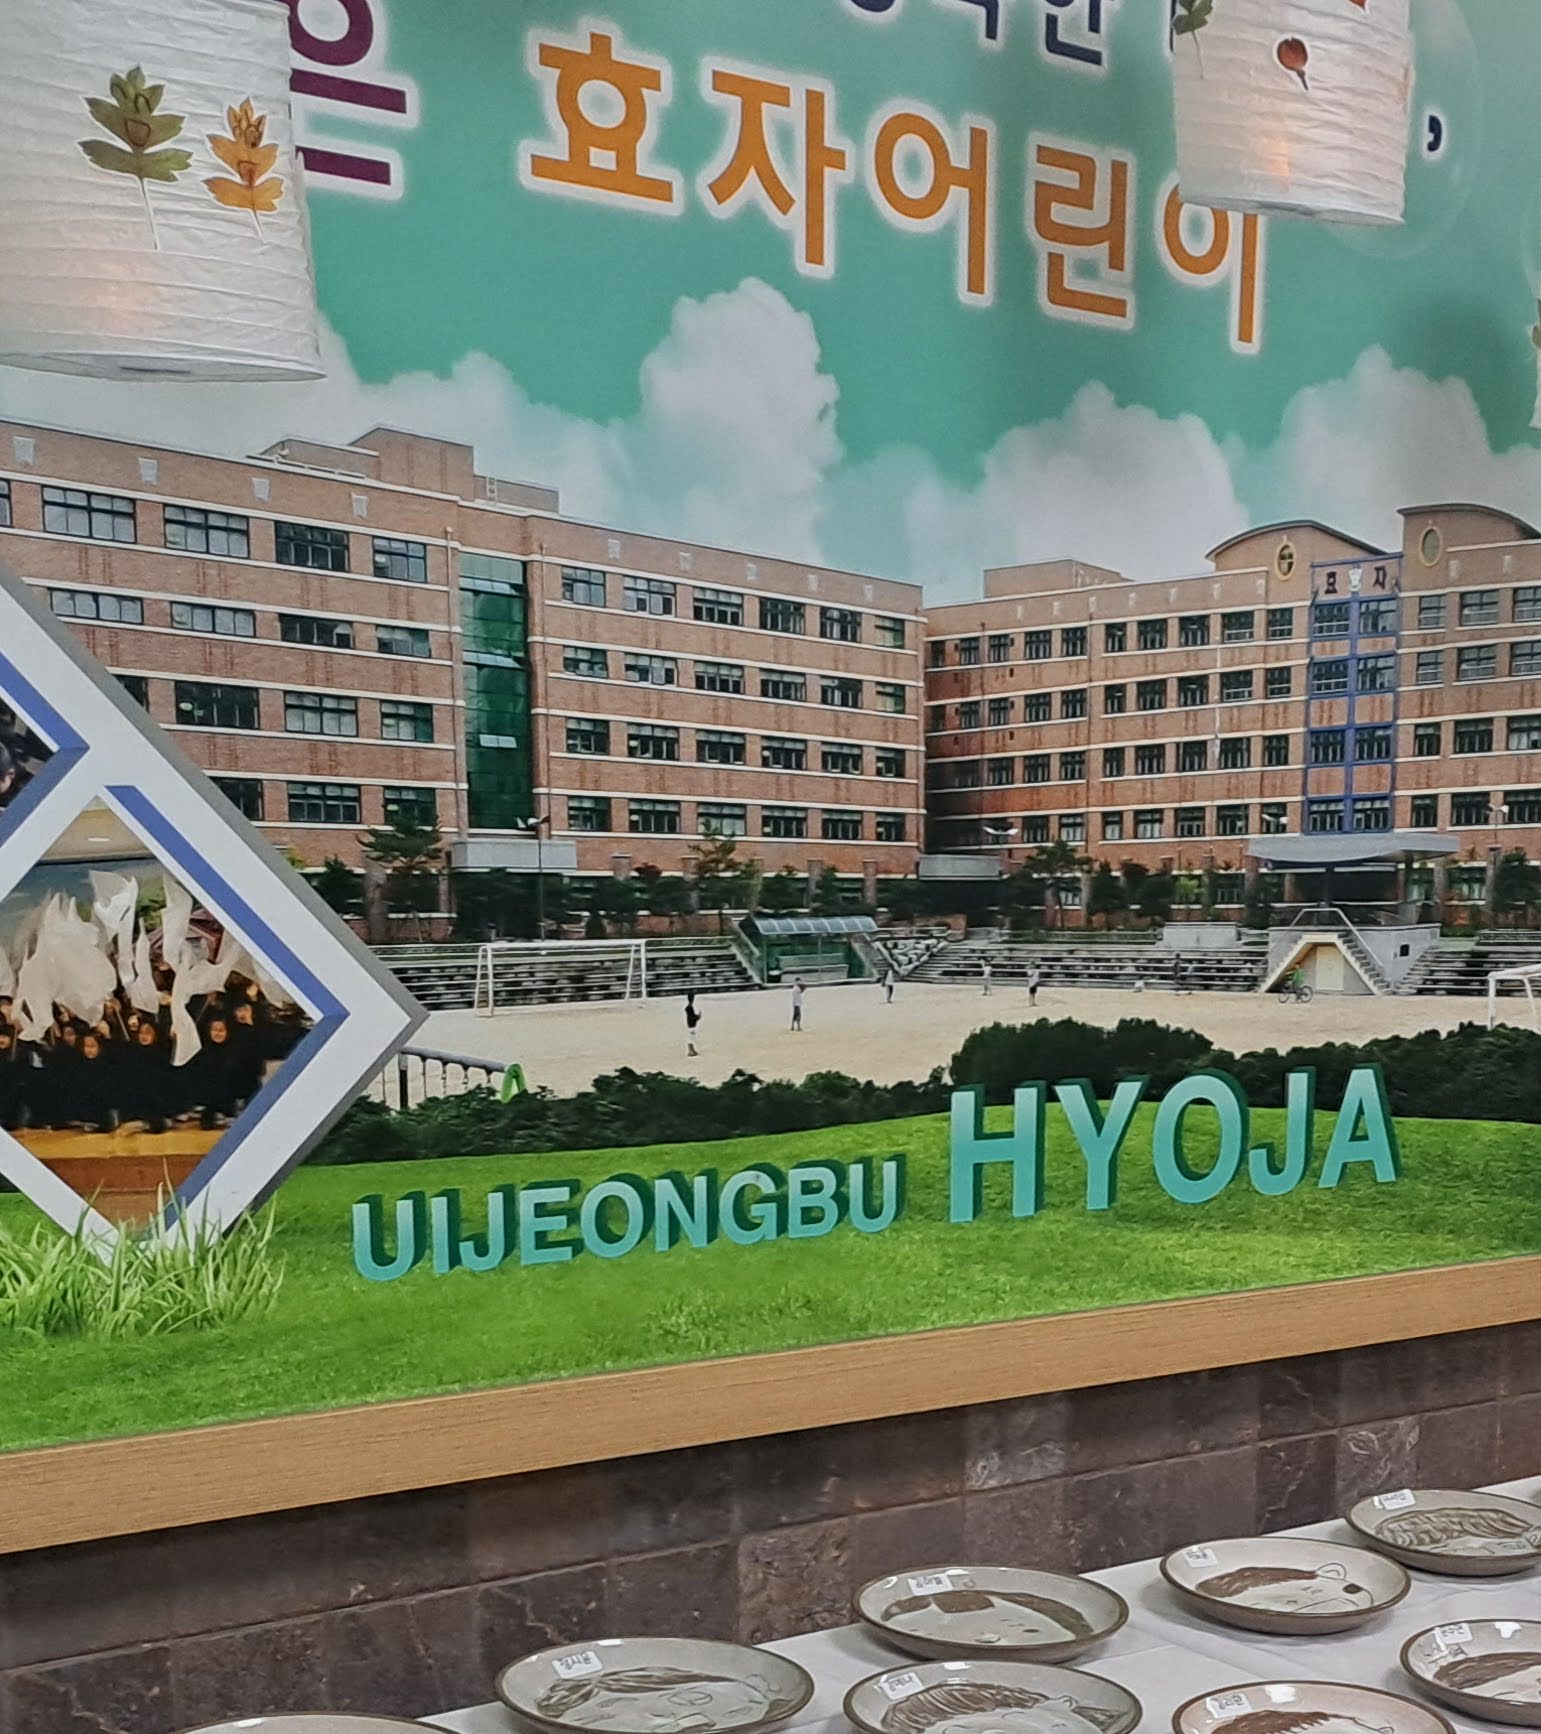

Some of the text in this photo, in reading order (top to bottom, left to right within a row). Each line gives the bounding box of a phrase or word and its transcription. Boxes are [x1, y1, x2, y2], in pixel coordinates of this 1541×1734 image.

[529, 32, 1258, 343] 효자어린이
[352, 1066, 1397, 1282] UIJEONGBU HYOJA
